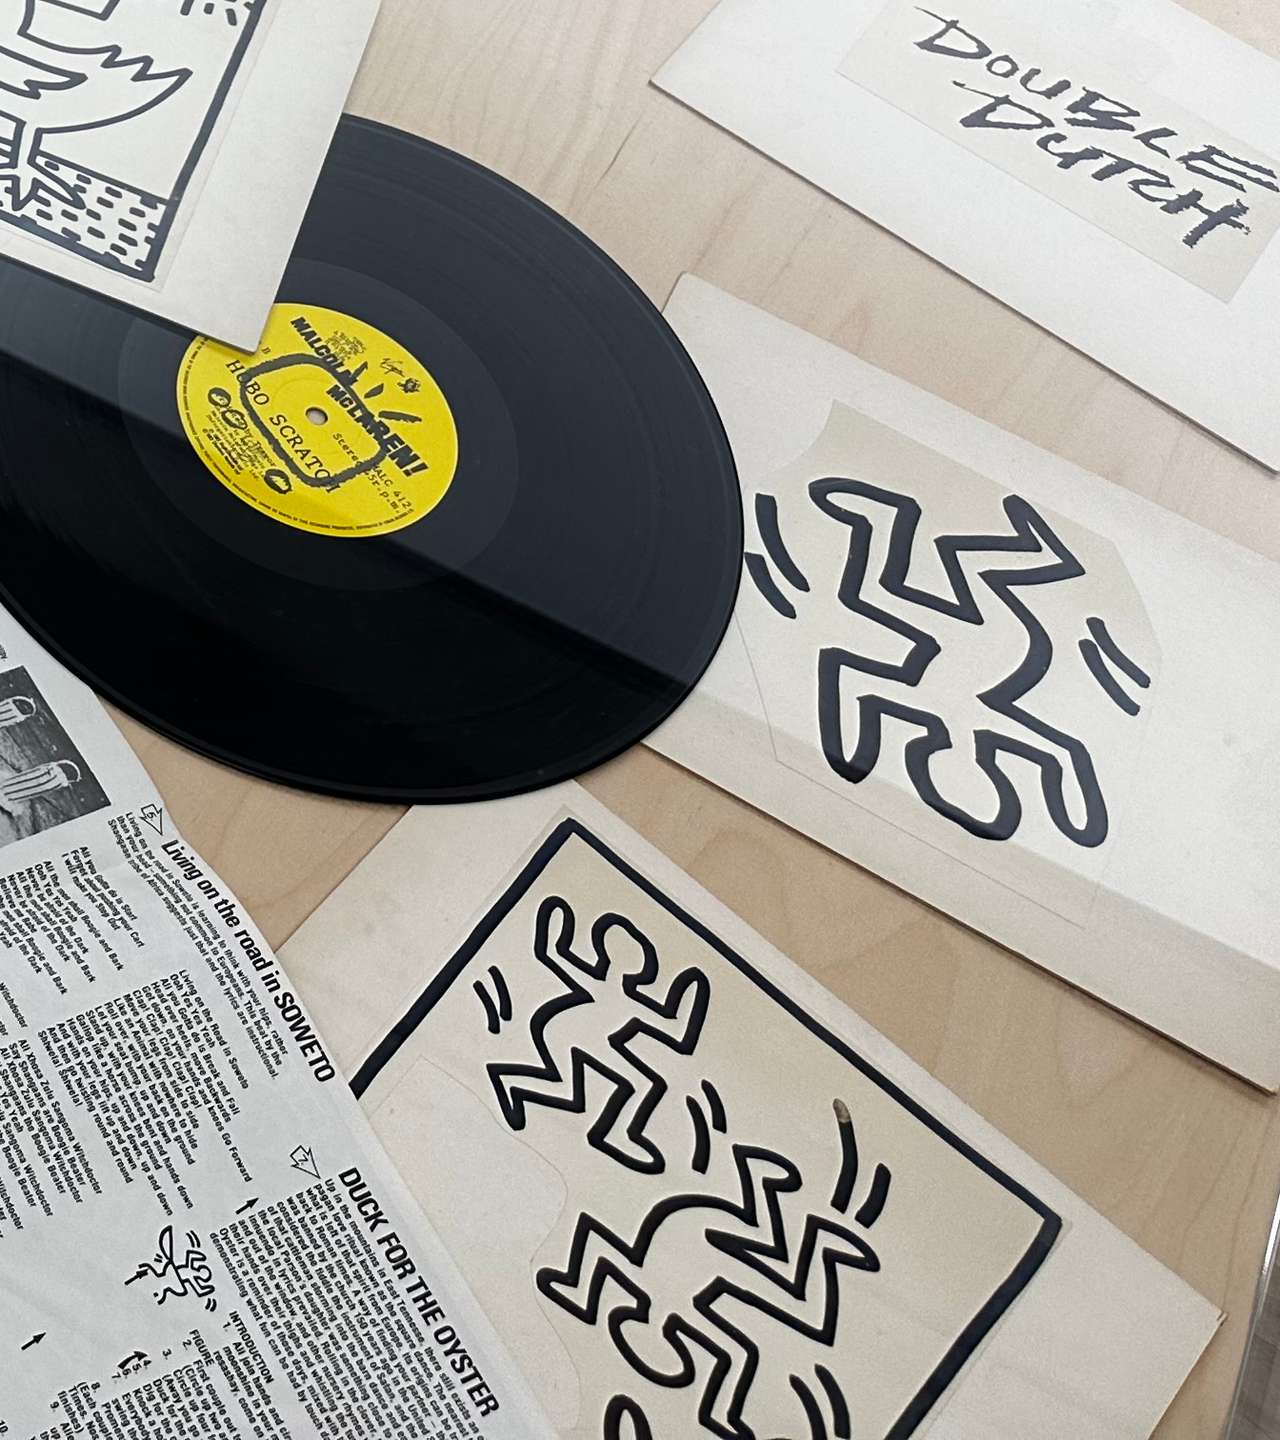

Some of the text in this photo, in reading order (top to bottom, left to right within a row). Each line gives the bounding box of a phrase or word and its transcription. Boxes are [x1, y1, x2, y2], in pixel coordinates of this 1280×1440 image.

[913, 5, 1280, 193] DOUBLE
[953, 80, 1251, 249] DUTCH
[226, 360, 270, 406] HOBO
[290, 316, 359, 387] MALCOLM
[326, 384, 430, 477] MCLAREN!
[161, 839, 335, 1081] Living on the road in SOWETO
[338, 1167, 498, 1416] DUCK FOR THE OYSTER
[188, 1329, 215, 1366] FIGURE
[228, 1311, 275, 1385] INTRODUCTION
